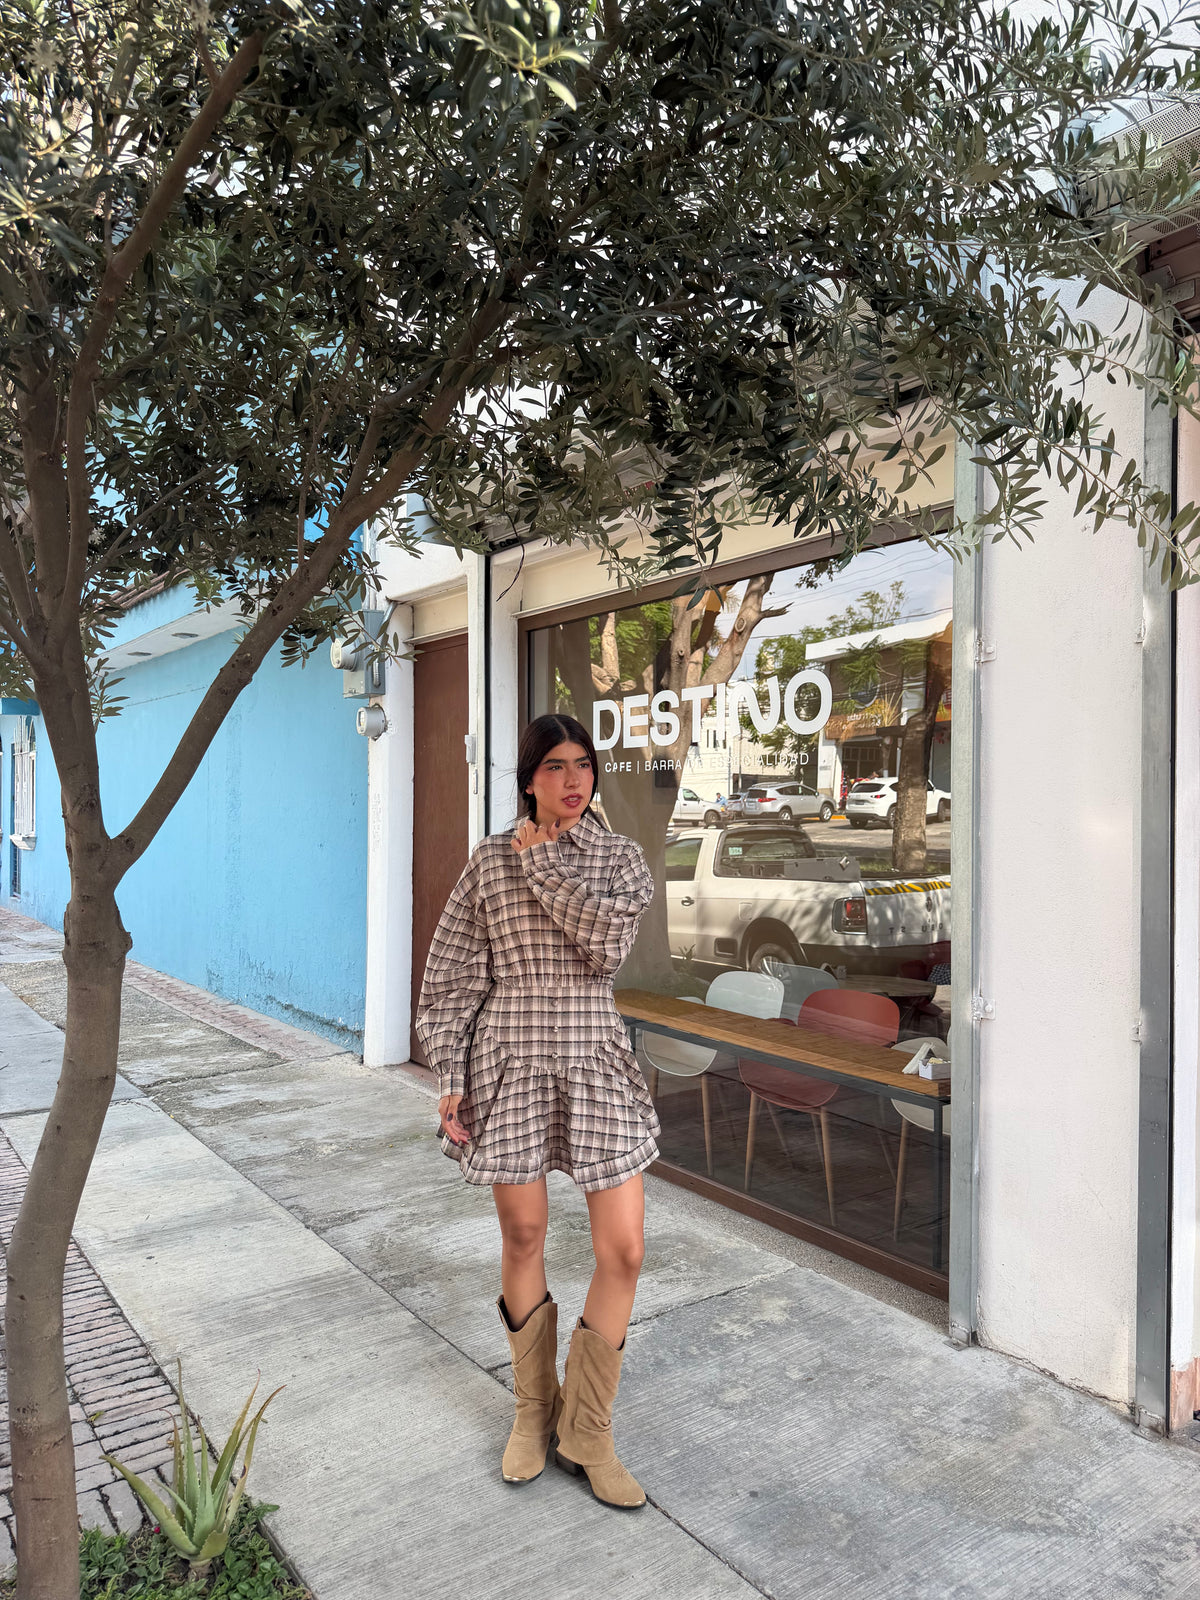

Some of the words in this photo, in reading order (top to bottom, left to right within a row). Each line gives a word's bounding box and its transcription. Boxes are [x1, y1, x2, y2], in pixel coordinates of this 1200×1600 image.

[592, 670, 833, 751] DESTINO
[604, 761, 632, 773] CAFE
[644, 759, 682, 772] BARRA
